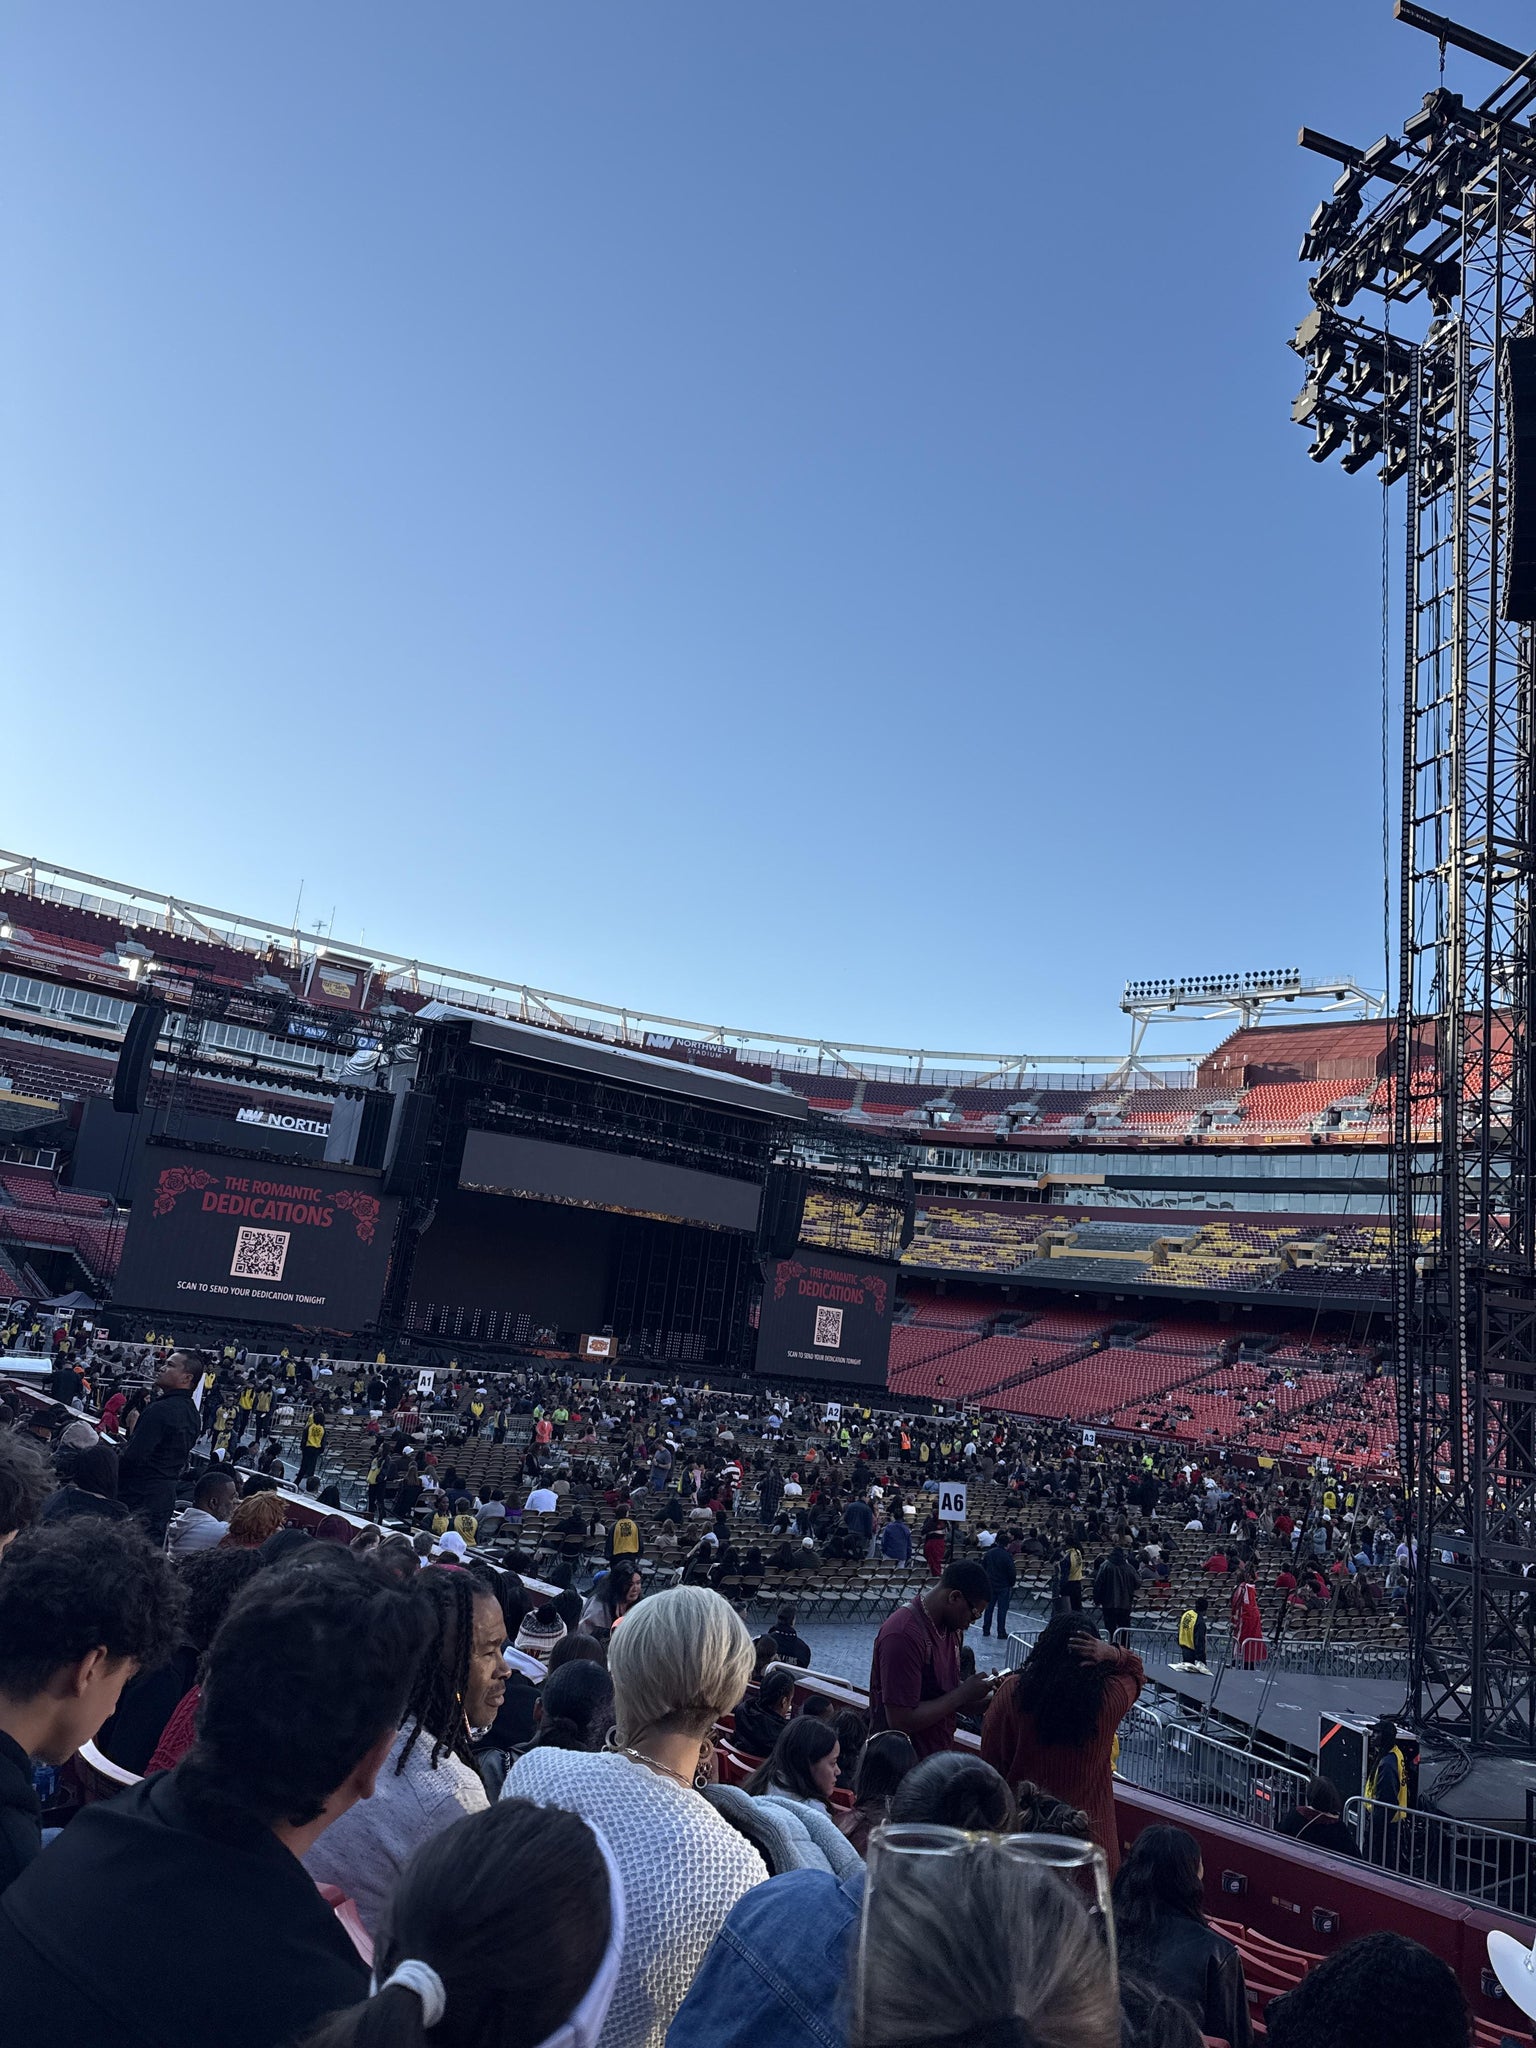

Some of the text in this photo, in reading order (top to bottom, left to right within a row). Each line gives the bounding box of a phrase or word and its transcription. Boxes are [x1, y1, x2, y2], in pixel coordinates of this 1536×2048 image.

[676, 1038, 734, 1055] NORTHWEST
[687, 1048, 722, 1058] STADIUM
[224, 1176, 323, 1202] THE ROMANTIC
[201, 1191, 335, 1228] DEDICATIONS
[809, 1266, 858, 1285] THE ROMANTIC
[176, 1280, 327, 1305] SCAN TO SEND YOUR DEDICATION TONIGHT
[798, 1279, 865, 1305] DEDICATIONS
[787, 1350, 798, 1358] SCAN
[803, 1352, 814, 1360] SEND
[814, 1353, 825, 1361] YOUR
[420, 1376, 431, 1386] A1
[828, 1407, 839, 1417] A2
[1084, 1433, 1094, 1443] A3
[941, 1492, 964, 1512] A6
